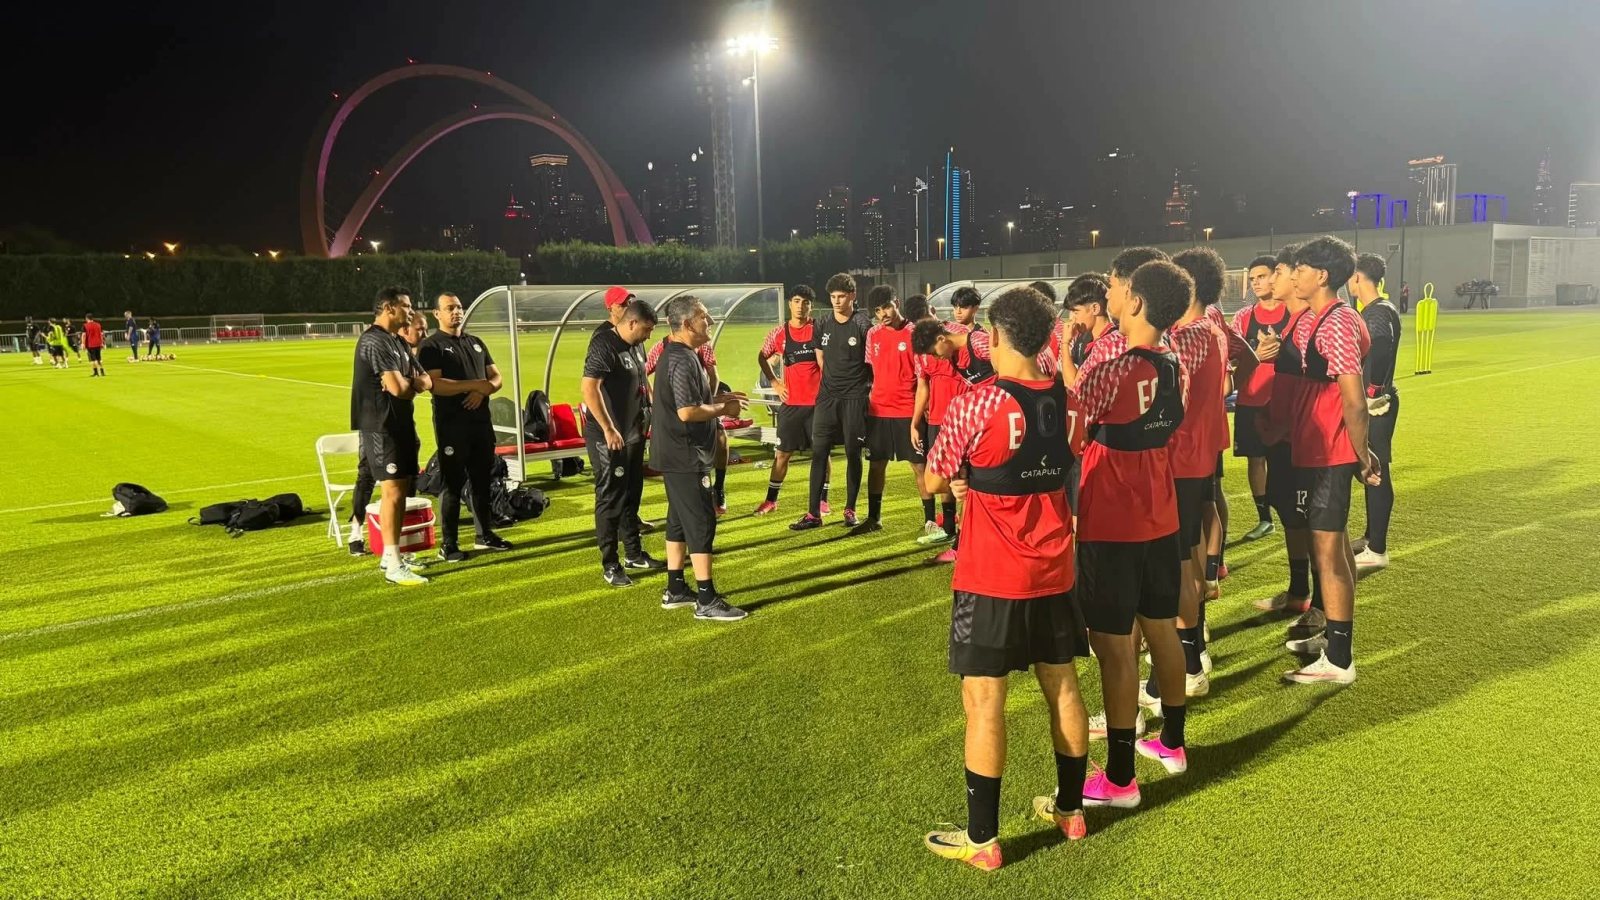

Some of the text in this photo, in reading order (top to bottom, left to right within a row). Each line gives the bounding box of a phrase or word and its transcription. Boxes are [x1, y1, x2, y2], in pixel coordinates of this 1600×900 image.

[1144, 420, 1173, 430] CATAPULT
[1020, 467, 1062, 479] CATAPULT
[1296, 490, 1307, 505] 17
